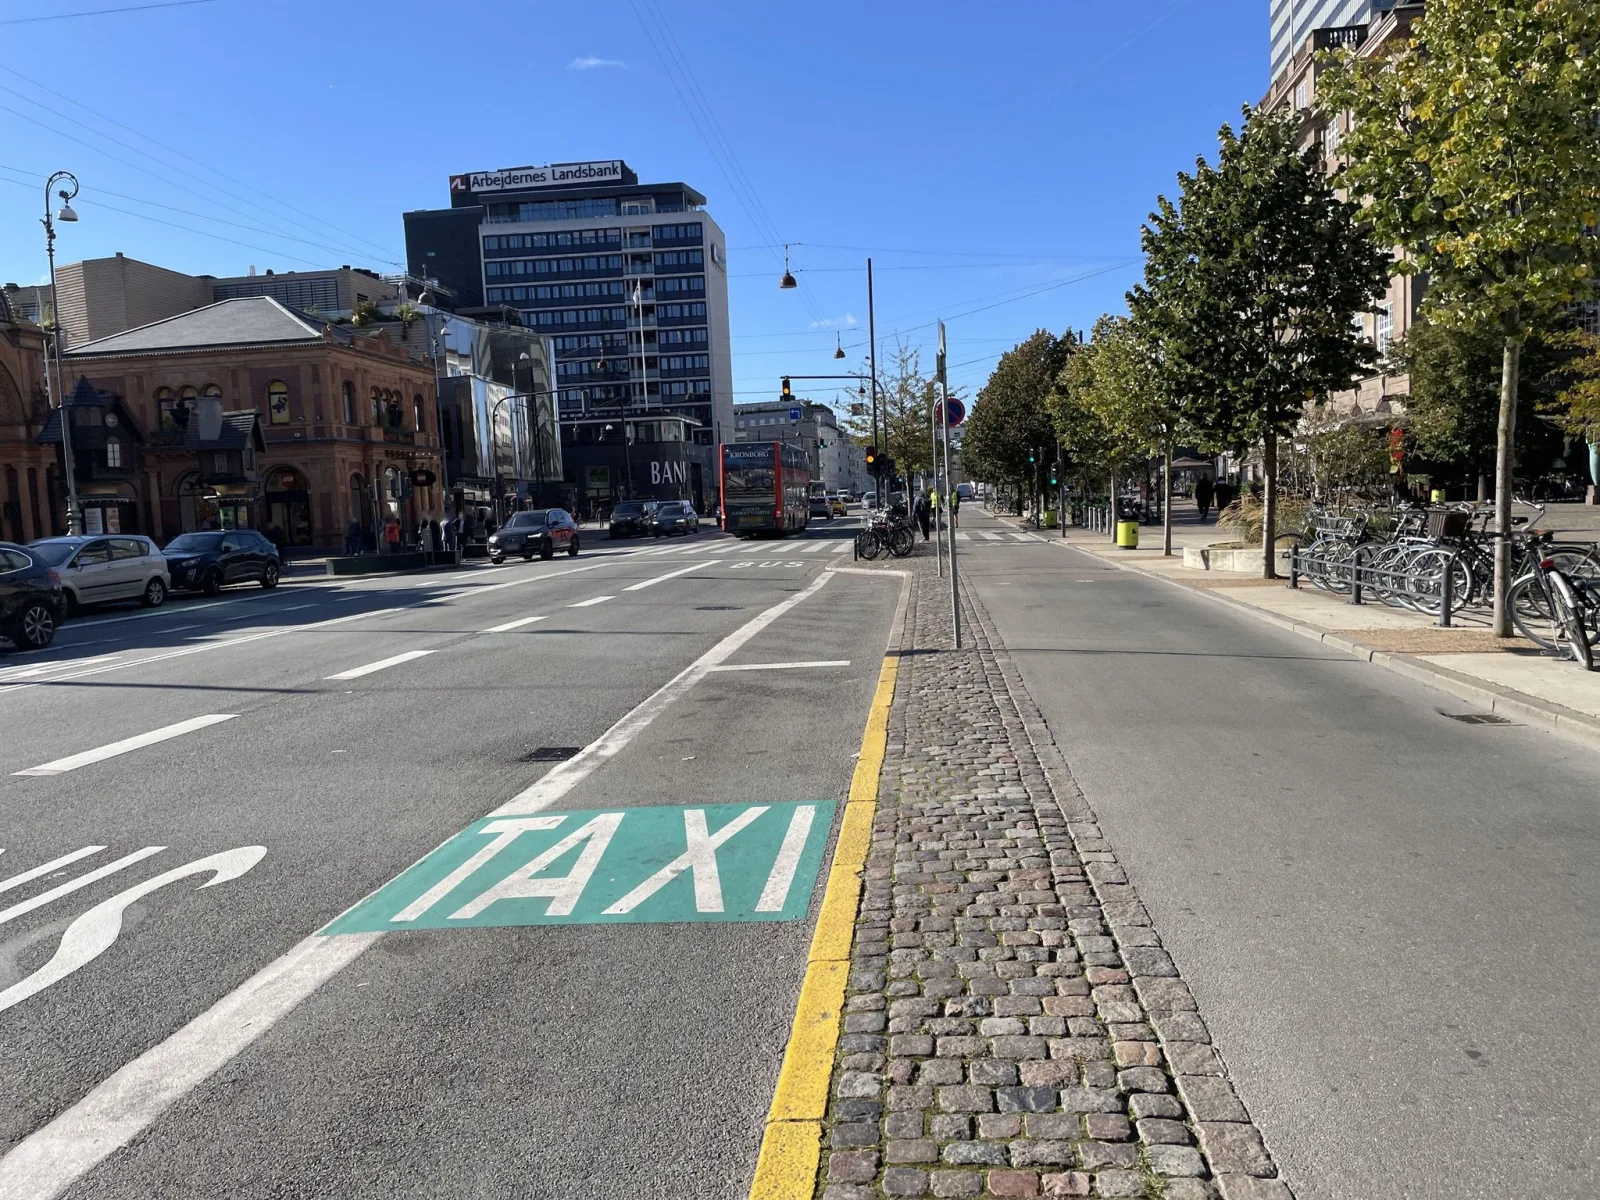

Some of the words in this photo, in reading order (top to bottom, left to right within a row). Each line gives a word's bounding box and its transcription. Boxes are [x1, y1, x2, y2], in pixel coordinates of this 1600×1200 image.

[471, 171, 547, 188] Arbejdernes
[552, 162, 620, 181] Landsbank
[730, 451, 769, 459] KRONBORG
[729, 561, 805, 569] BUS
[389, 805, 817, 922] TAXI
